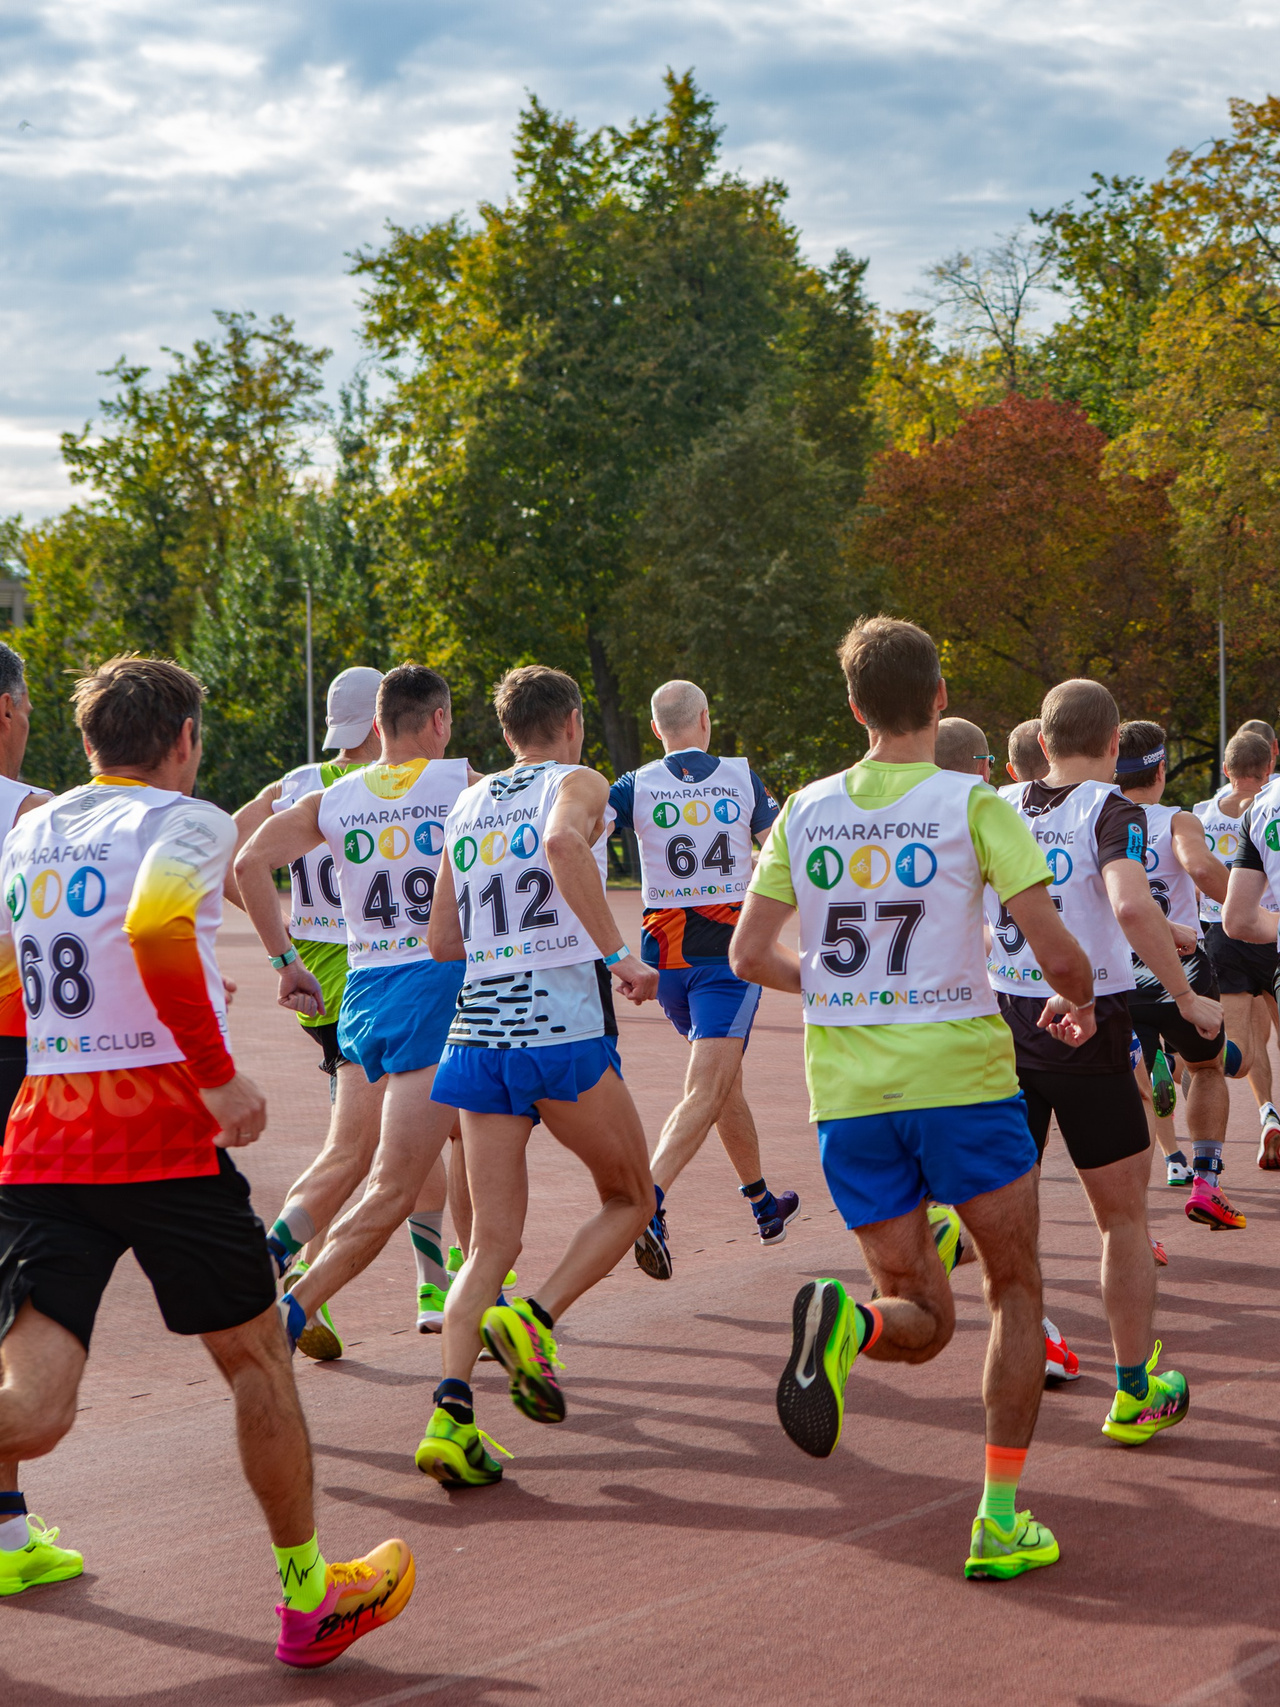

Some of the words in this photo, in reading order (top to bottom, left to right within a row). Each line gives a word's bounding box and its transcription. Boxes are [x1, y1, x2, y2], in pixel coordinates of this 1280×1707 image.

[650, 786, 740, 800] VMARAFONE
[339, 804, 449, 828] VMARAFONE
[455, 805, 539, 836] VMARAFONE
[1204, 823, 1240, 832] MARAF
[805, 822, 940, 843] VMARAFONE
[10, 843, 111, 869] VMARAFONE
[665, 831, 736, 879] 64
[362, 866, 437, 930] 49
[457, 867, 559, 943] 112
[1148, 878, 1171, 918] 6
[356, 936, 429, 953] VMARAFON
[468, 935, 579, 964] ARAFONE.CLUB
[820, 899, 926, 978] 57
[18, 932, 95, 1020] 68
[806, 986, 973, 1008] VMARAFONE.CLUB
